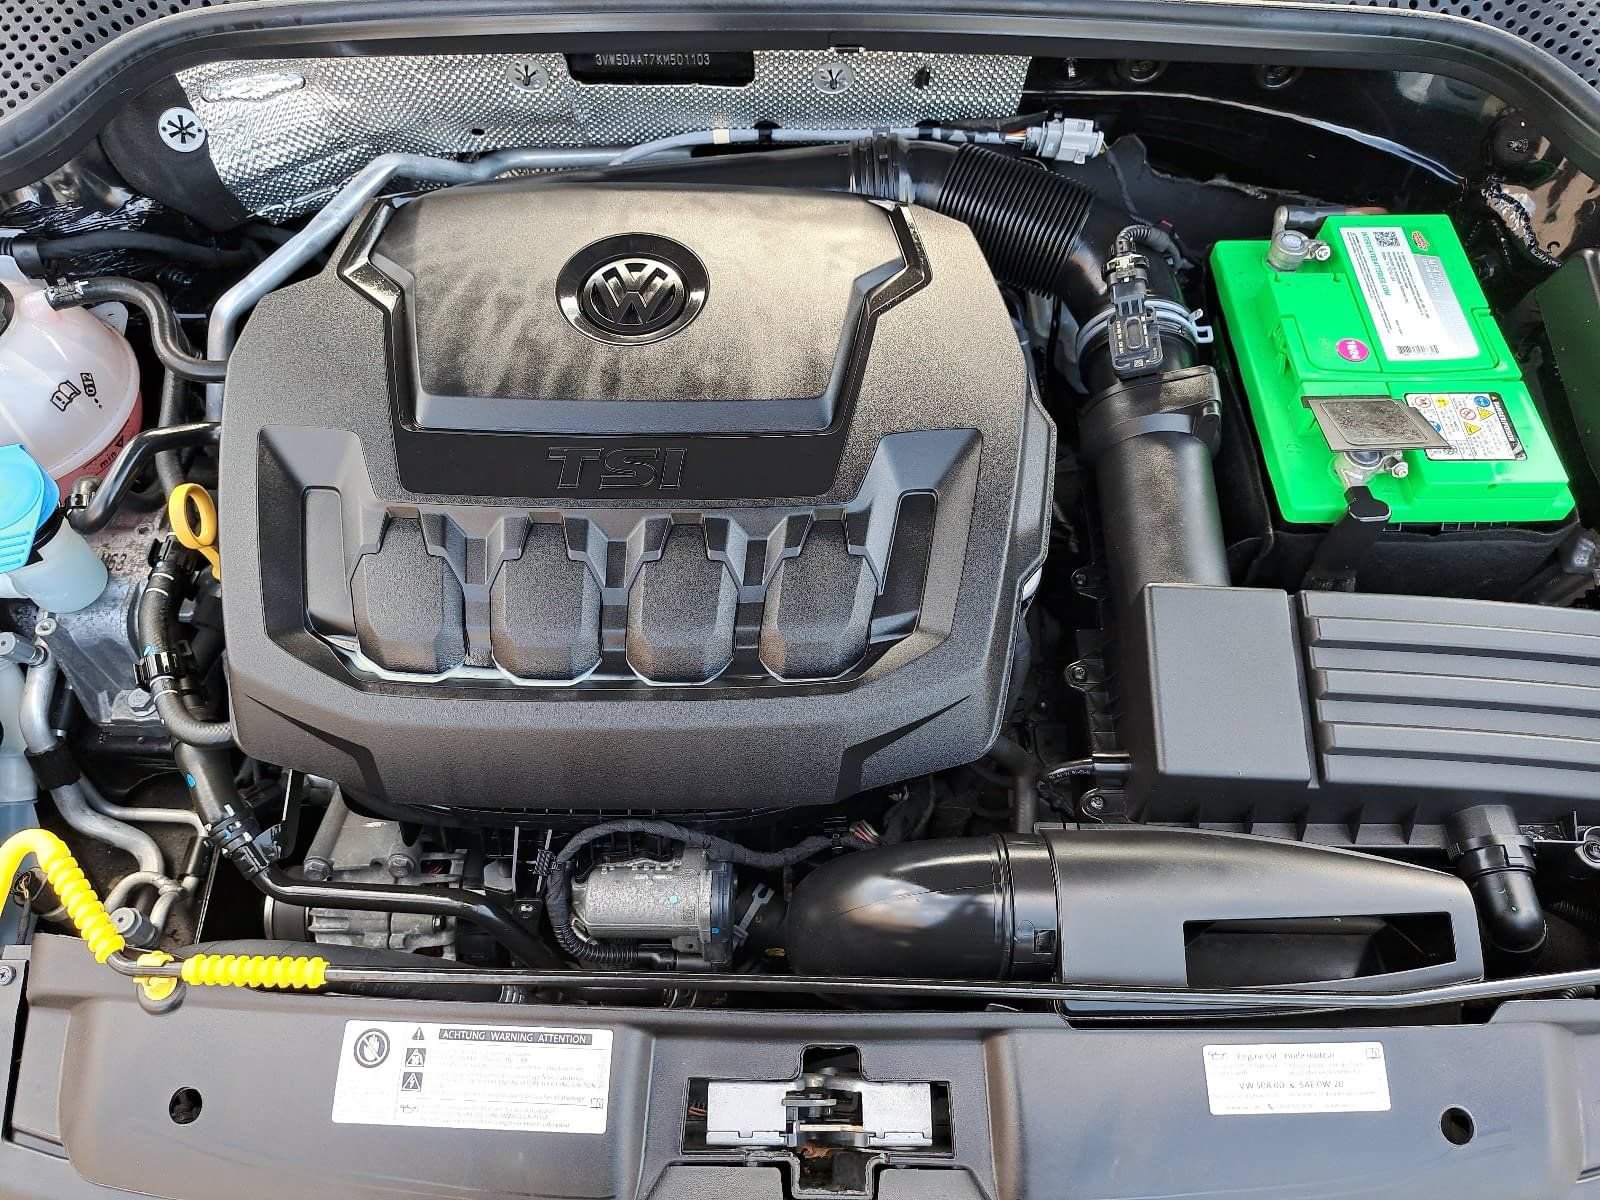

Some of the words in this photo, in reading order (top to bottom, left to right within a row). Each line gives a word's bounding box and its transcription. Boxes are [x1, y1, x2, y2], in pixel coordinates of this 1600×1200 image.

[588, 259, 682, 325] VW
[99, 451, 117, 469] min
[546, 447, 687, 489] TSI
[442, 1030, 486, 1041] ACHTUNG
[490, 1032, 534, 1042] WARNING
[537, 1033, 587, 1044] ATTENTION
